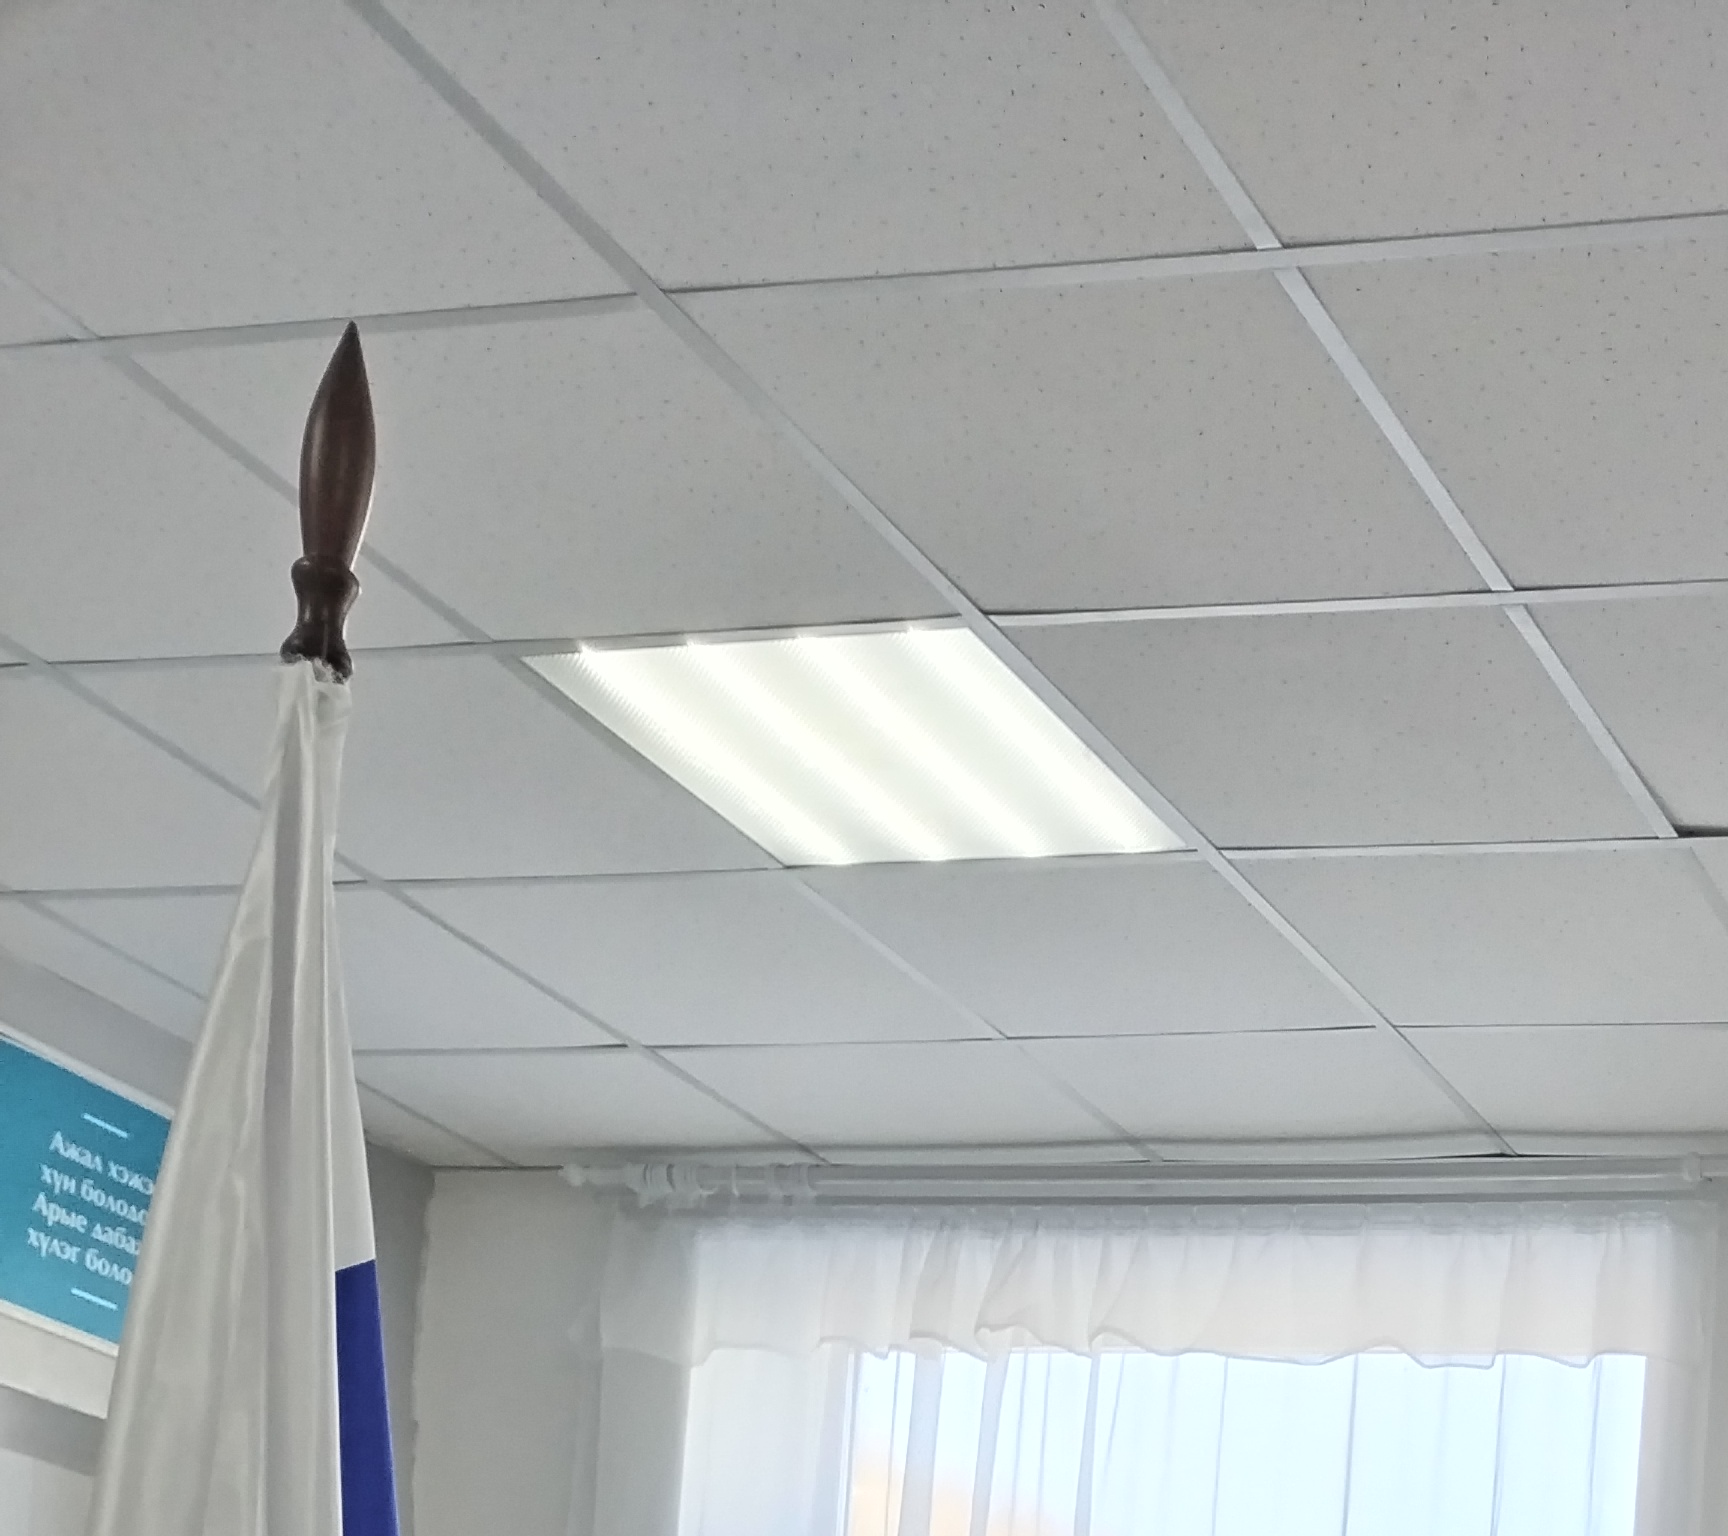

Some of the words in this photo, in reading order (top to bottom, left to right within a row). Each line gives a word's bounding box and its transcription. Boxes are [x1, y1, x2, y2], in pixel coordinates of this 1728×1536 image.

[49, 1131, 102, 1173] Ажал
[80, 1179, 149, 1227] болодо
[92, 1224, 142, 1256] даба
[86, 1249, 134, 1286] боло
